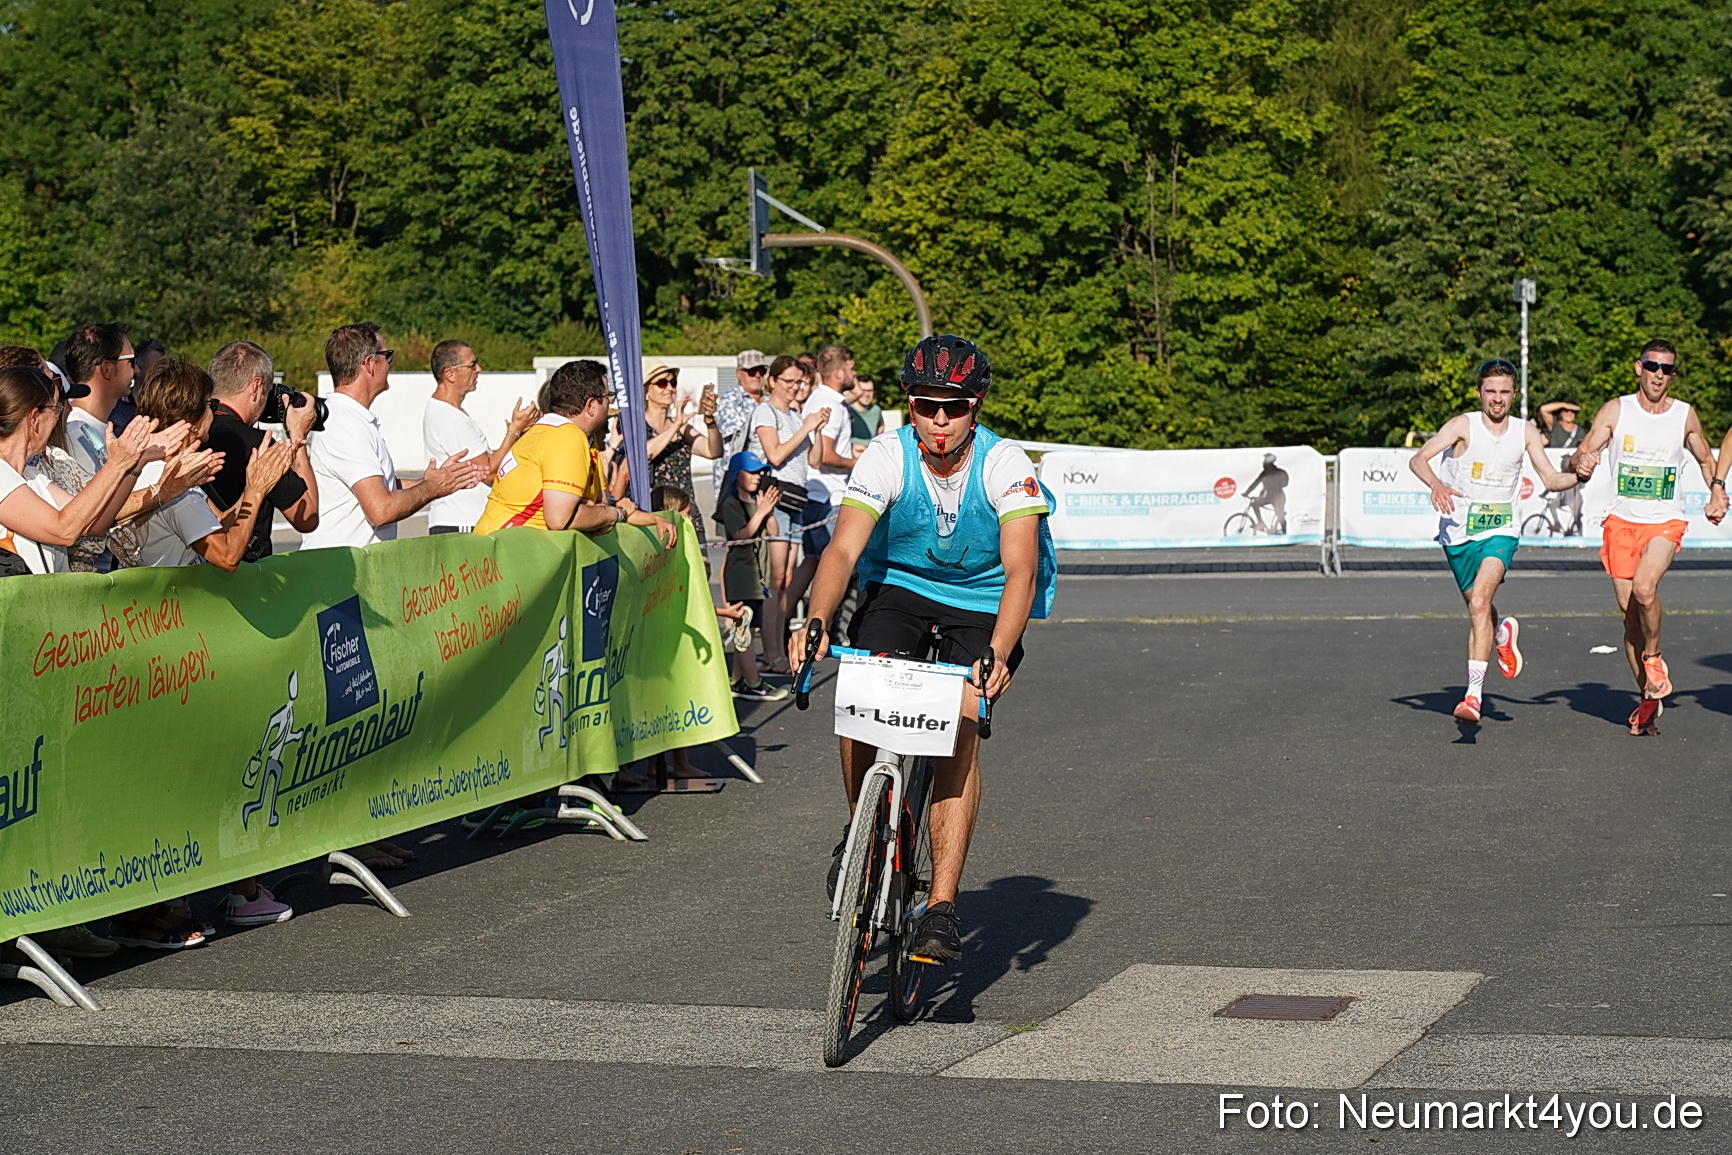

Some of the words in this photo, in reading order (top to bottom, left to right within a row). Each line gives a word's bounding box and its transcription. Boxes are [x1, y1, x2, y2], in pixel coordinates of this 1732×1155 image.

[1063, 471, 1099, 484] NOW
[1362, 469, 1398, 482] NOW
[1628, 476, 1653, 489] 475
[1066, 494, 1118, 507] E-BIKES
[1120, 494, 1131, 505] &
[1134, 492, 1215, 506] FAHRRÄDER
[1364, 492, 1416, 505] E-BIKES
[1478, 514, 1502, 526] 476
[402, 562, 460, 624] Gesunde
[458, 557, 503, 597] Firmen
[433, 612, 480, 663] laufen
[478, 583, 522, 646] länger!
[33, 603, 125, 677] Gesunde
[122, 598, 185, 645] Firmen
[330, 636, 359, 664] Fischer
[74, 663, 140, 725] laufen
[147, 632, 216, 706] länger!
[335, 654, 361, 675] AUTOMOBILE
[290, 671, 424, 790] firmenlauf
[845, 704, 866, 719] 1.
[873, 708, 951, 732] Läufer
[286, 769, 346, 816] neumarkt
[367, 749, 512, 820] www.firmenlauf-oberpfalz.de
[0, 829, 203, 919] www.firmenlauf-oberpfalz.de
